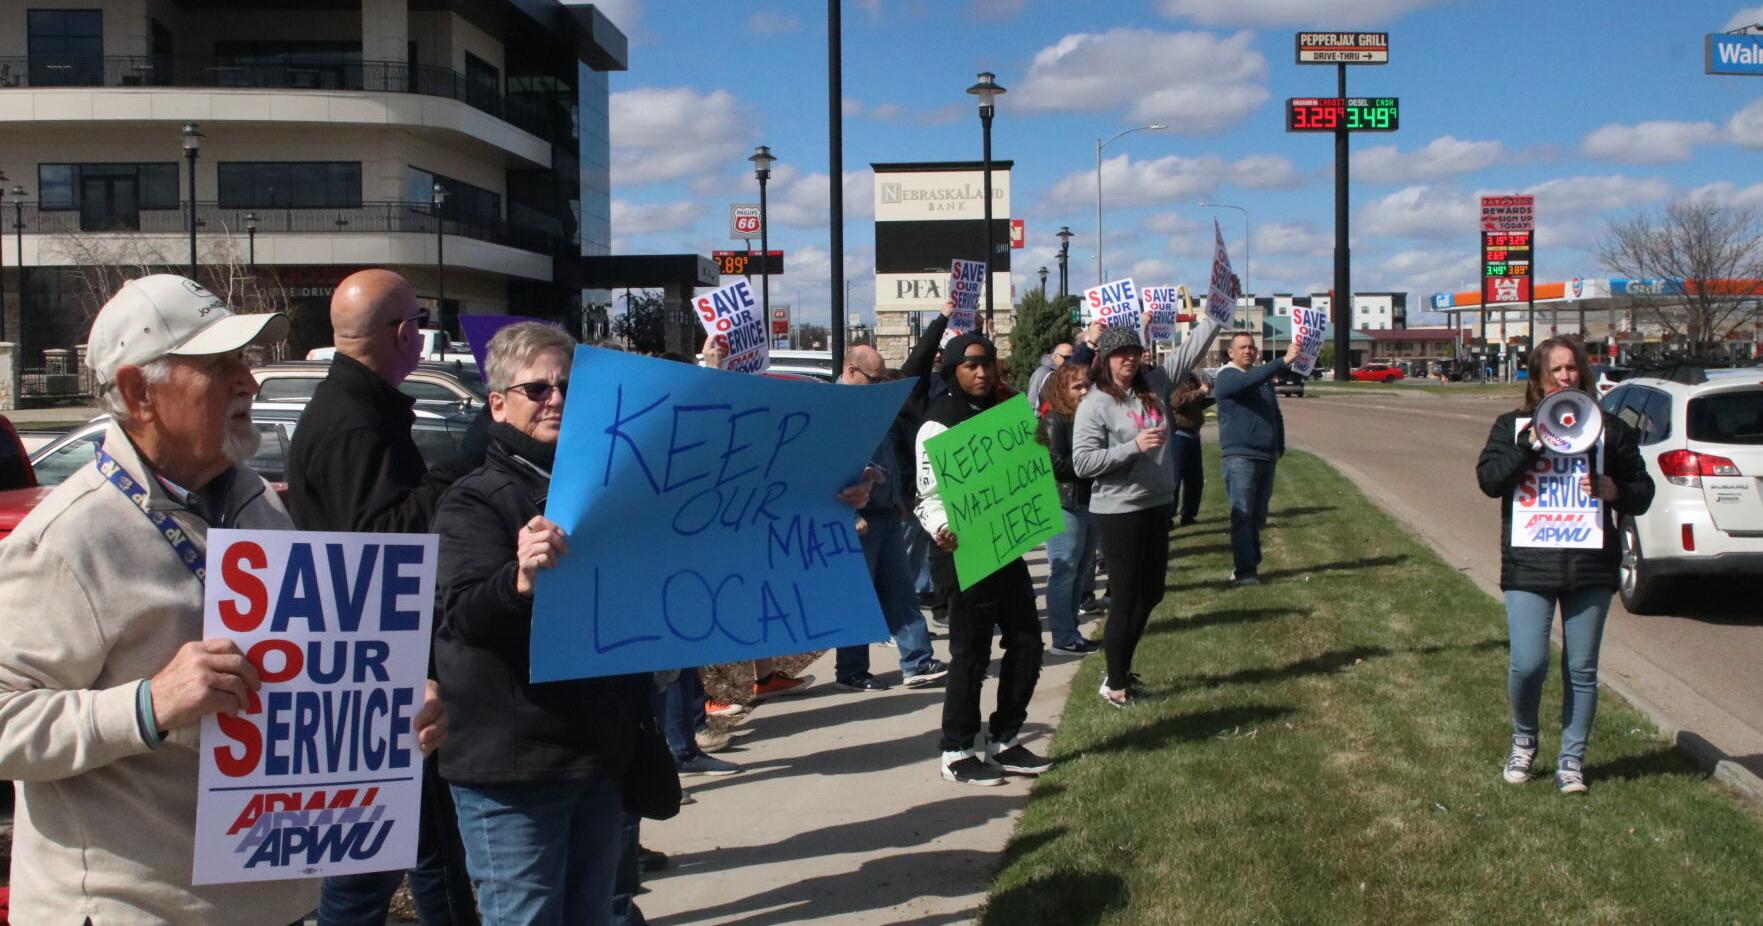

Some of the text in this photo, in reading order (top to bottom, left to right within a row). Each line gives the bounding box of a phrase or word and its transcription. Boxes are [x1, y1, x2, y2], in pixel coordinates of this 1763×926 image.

[1301, 34, 1387, 46] PEPPERJAX GRILL
[1718, 42, 1763, 64] Wal
[928, 202, 966, 211] BANK
[738, 218, 756, 229] 66
[952, 261, 985, 282] SAVE
[896, 279, 942, 298] PFA
[956, 281, 978, 291] OUR
[1088, 280, 1134, 308] SAVE
[1144, 288, 1176, 303] SAVE
[697, 281, 755, 322] SAVE
[1100, 302, 1130, 316] OUR
[1150, 303, 1171, 311] OUR
[716, 309, 753, 331] OUR
[1293, 308, 1326, 331] SAVE
[715, 320, 765, 359] SERVICE
[1300, 326, 1321, 339] OUR
[604, 384, 811, 495] KEEP
[935, 420, 1034, 489] KEEP OUR
[1532, 457, 1588, 473] OUR
[951, 484, 1005, 532] MAIL
[1005, 456, 1051, 496] LOCAL
[672, 480, 789, 536] OUR
[990, 493, 1051, 563] HERE
[767, 515, 863, 571] MAIL
[218, 540, 425, 633] SAVE
[593, 566, 847, 654] LOCAL
[246, 639, 391, 684] OUR
[213, 687, 414, 778] SERVICE
[243, 819, 395, 869] APWU
